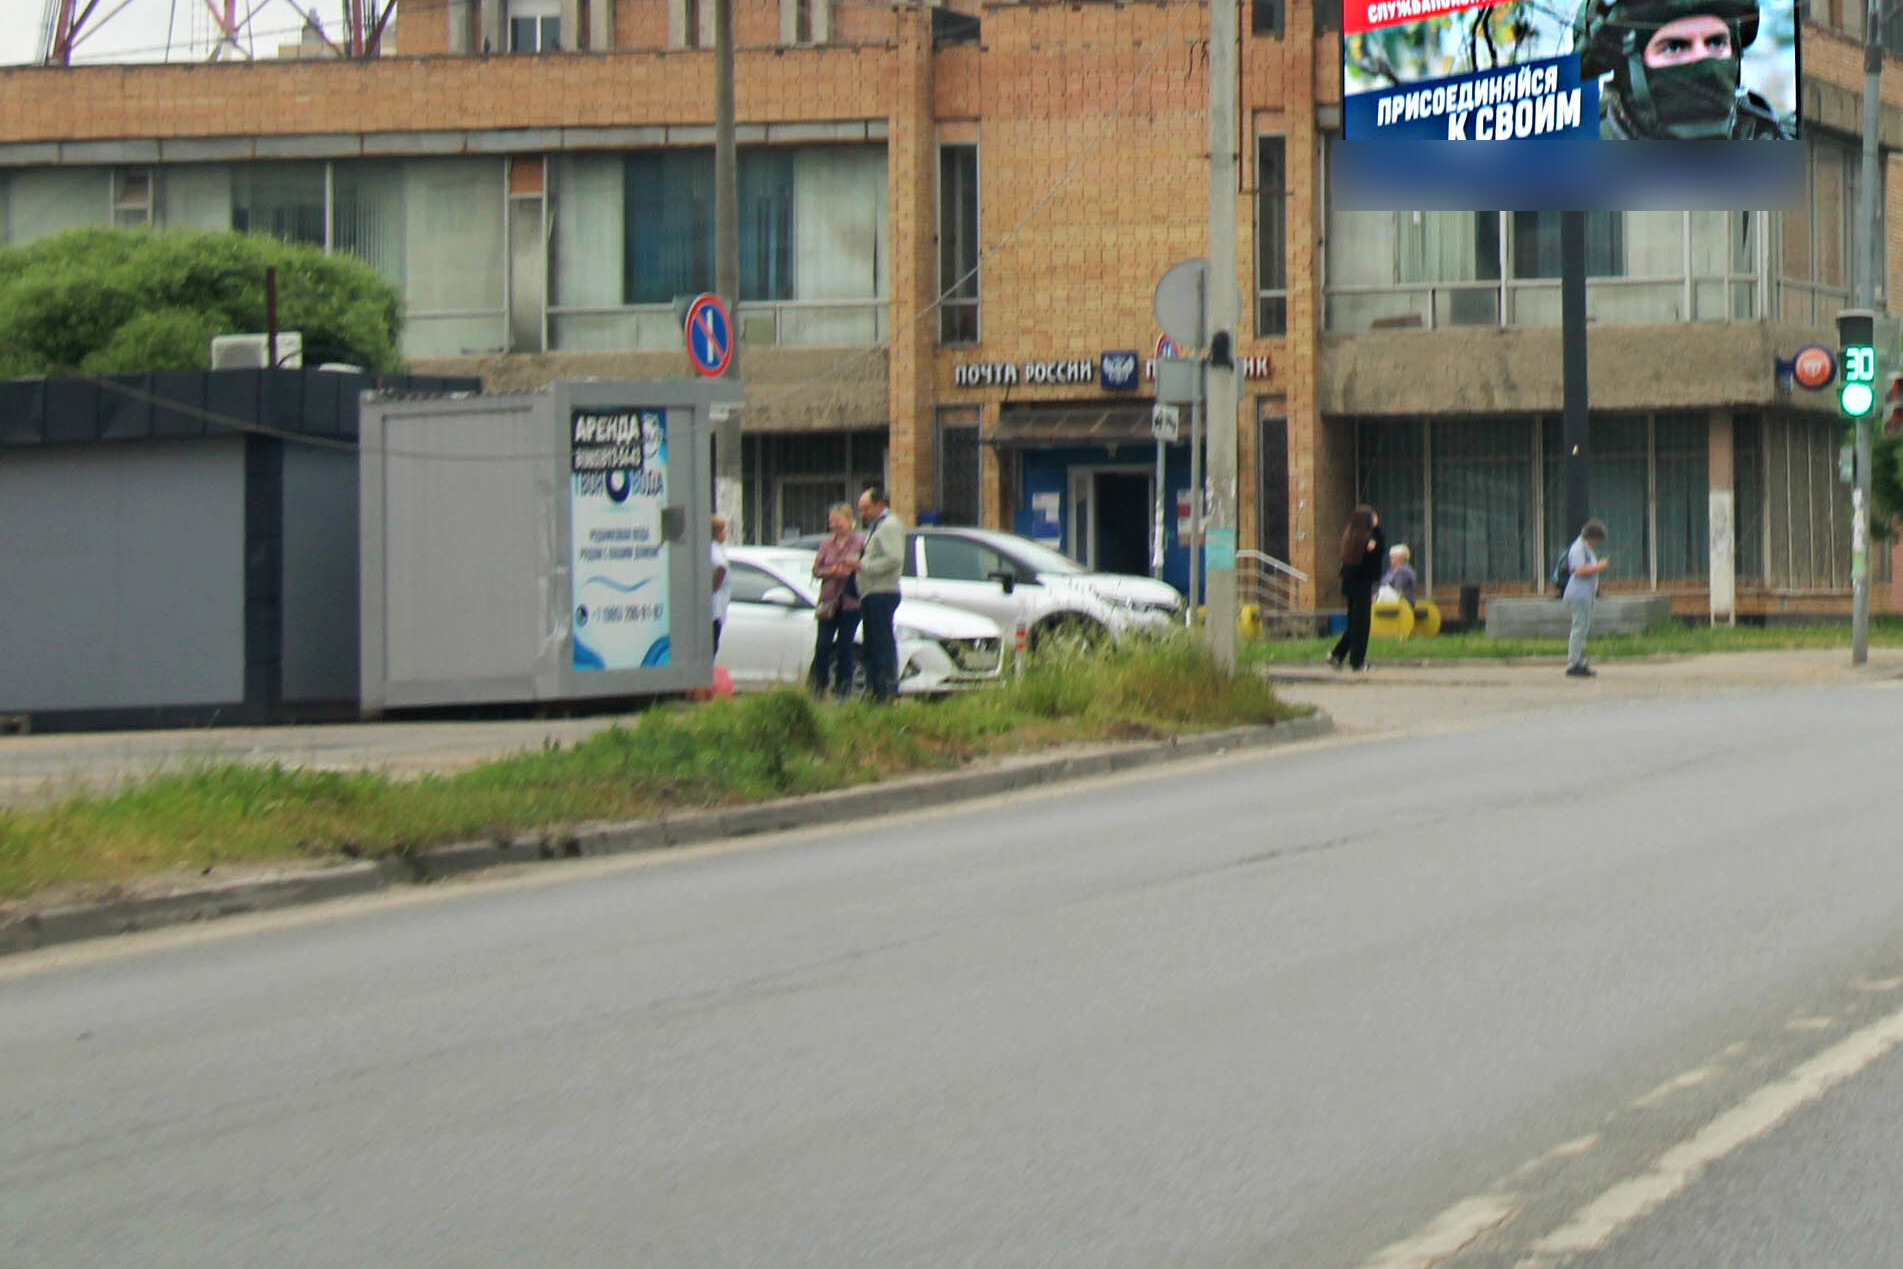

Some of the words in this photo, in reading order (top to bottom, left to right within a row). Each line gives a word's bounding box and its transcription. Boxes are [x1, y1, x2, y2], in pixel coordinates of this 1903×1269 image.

[1377, 65, 1559, 127] ПРИСОЕДИНЯЙСЯ
[1448, 111, 1468, 140] К
[1475, 88, 1582, 140] СВОИМ
[955, 363, 1018, 385] ПОЧТА
[1026, 360, 1093, 383] РОССИИ
[1846, 347, 1874, 381] 30
[575, 414, 641, 445] АРЕНДА
